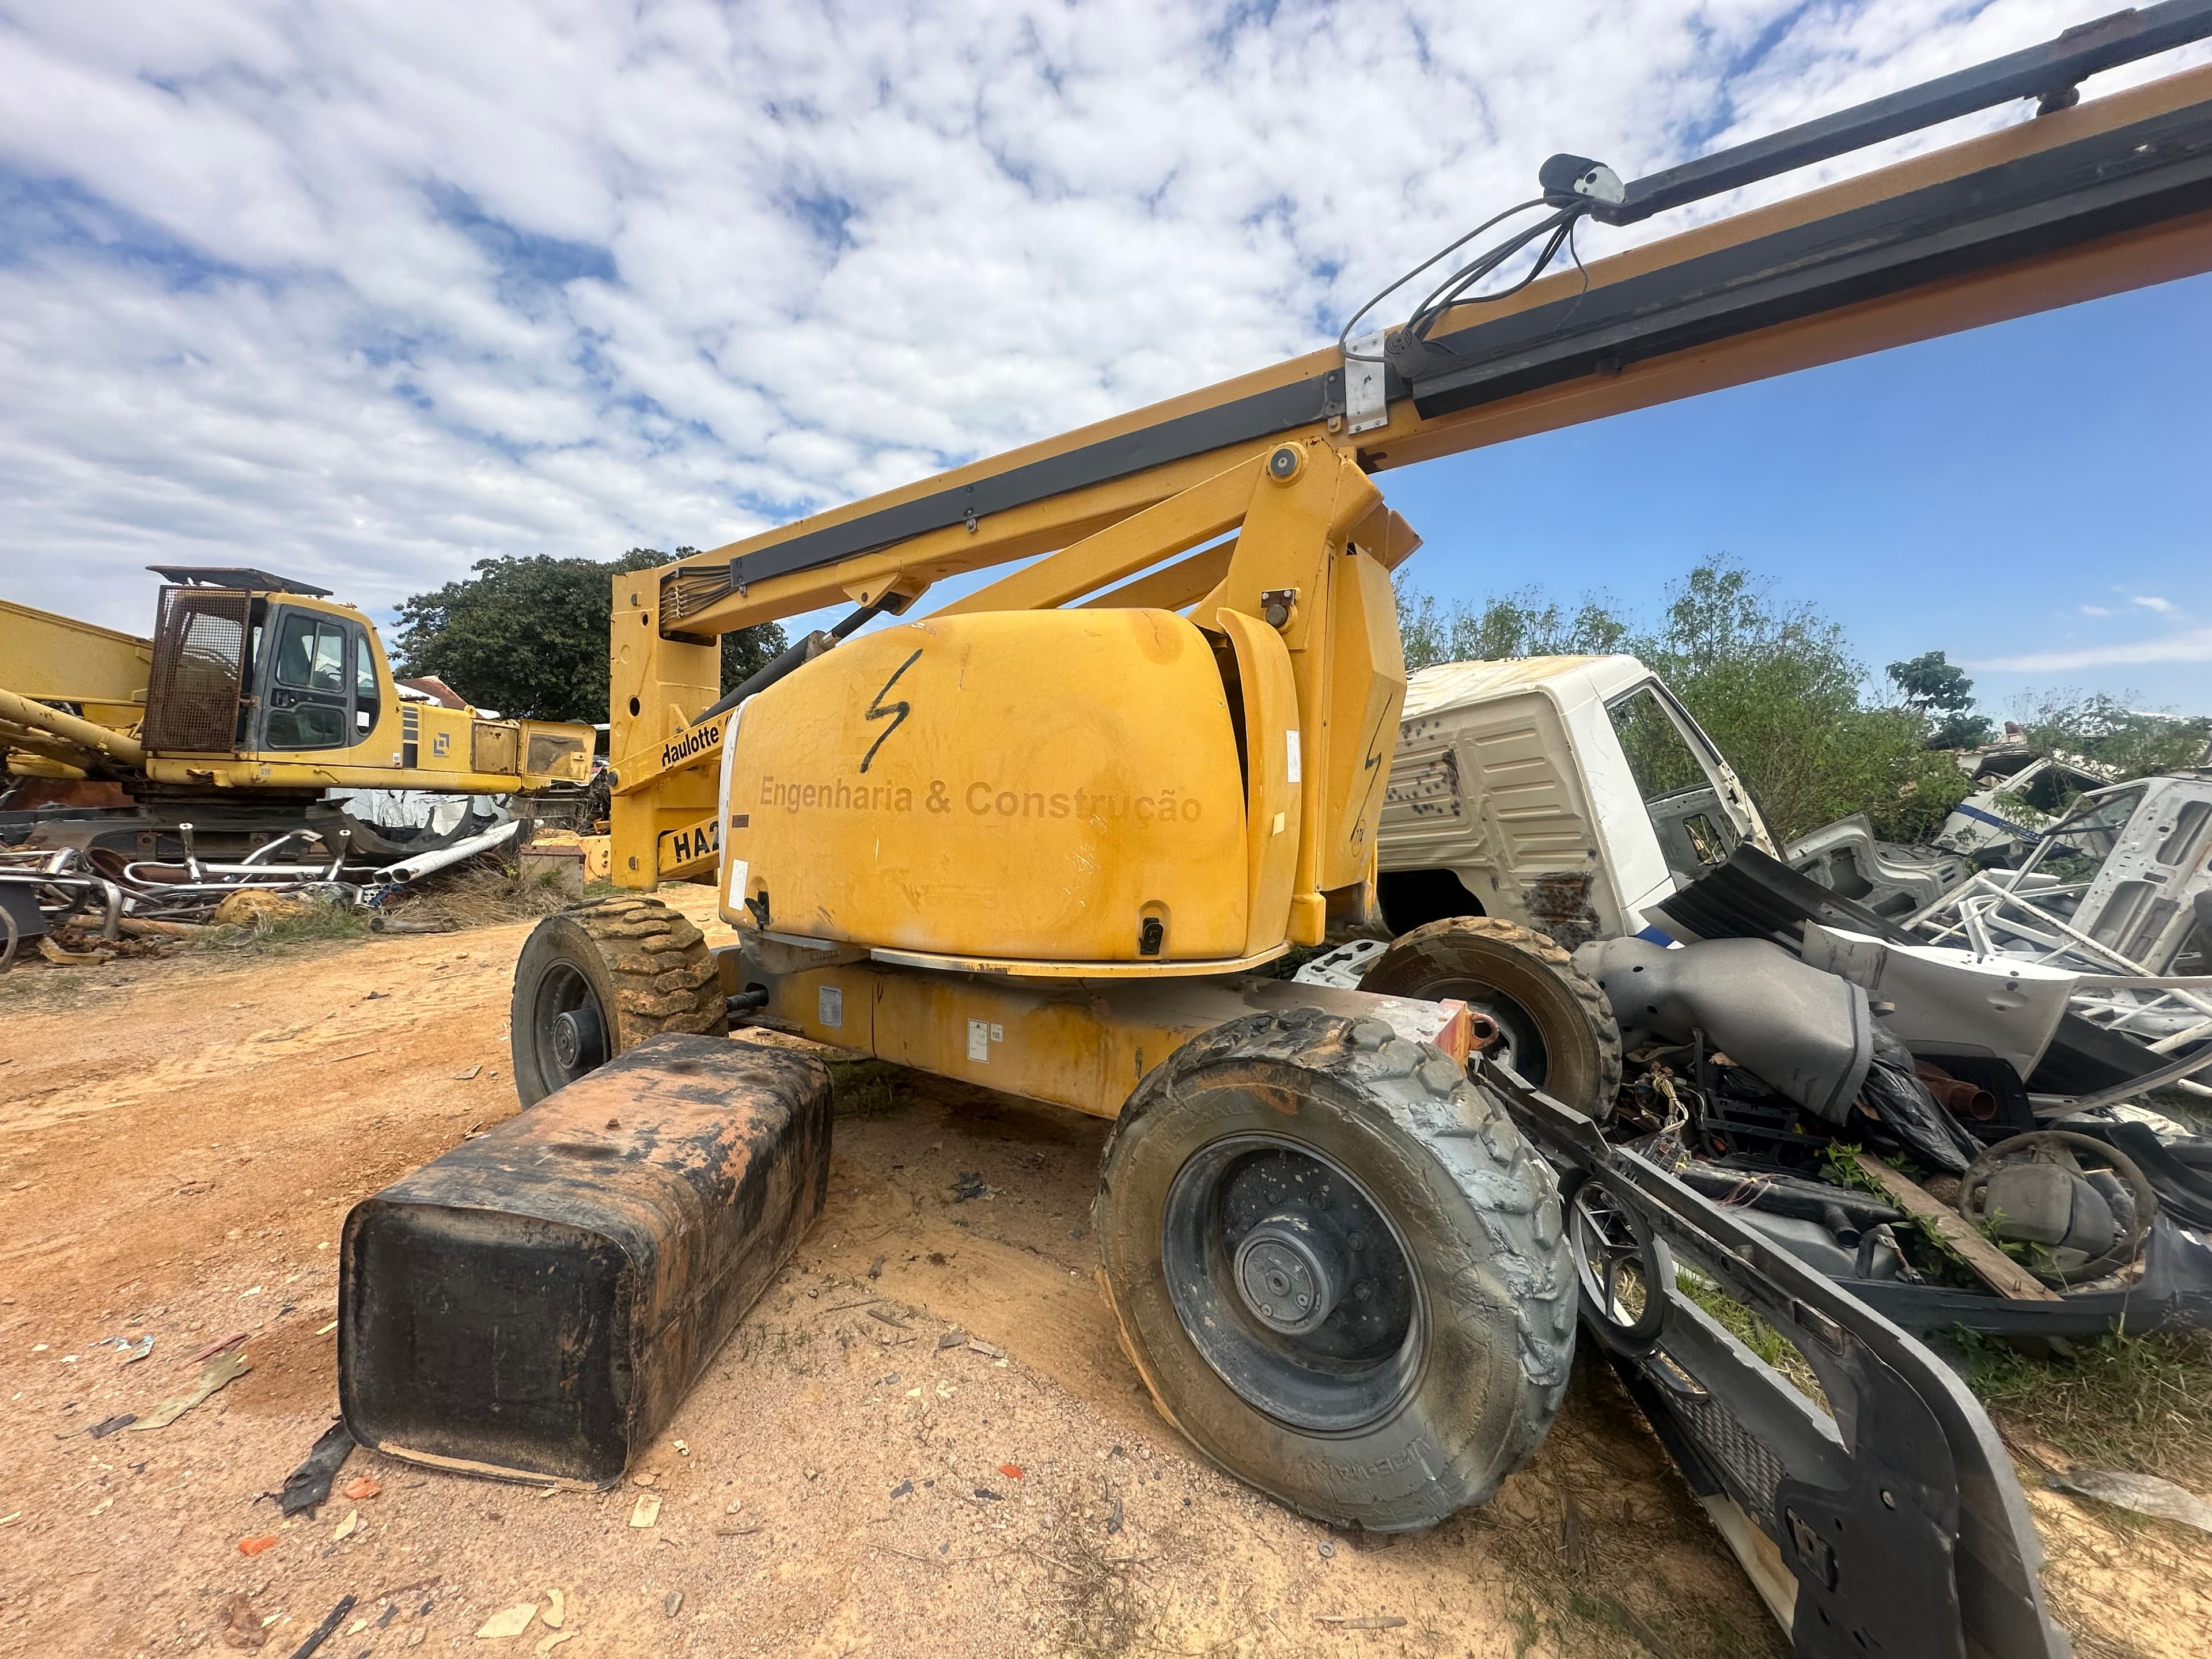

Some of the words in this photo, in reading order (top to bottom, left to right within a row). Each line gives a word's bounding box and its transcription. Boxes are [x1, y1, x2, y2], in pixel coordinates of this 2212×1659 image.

[661, 726, 719, 767] Haulotte
[760, 775, 912, 815] Engenharia
[925, 779, 952, 814] &
[965, 781, 1203, 828] Construção
